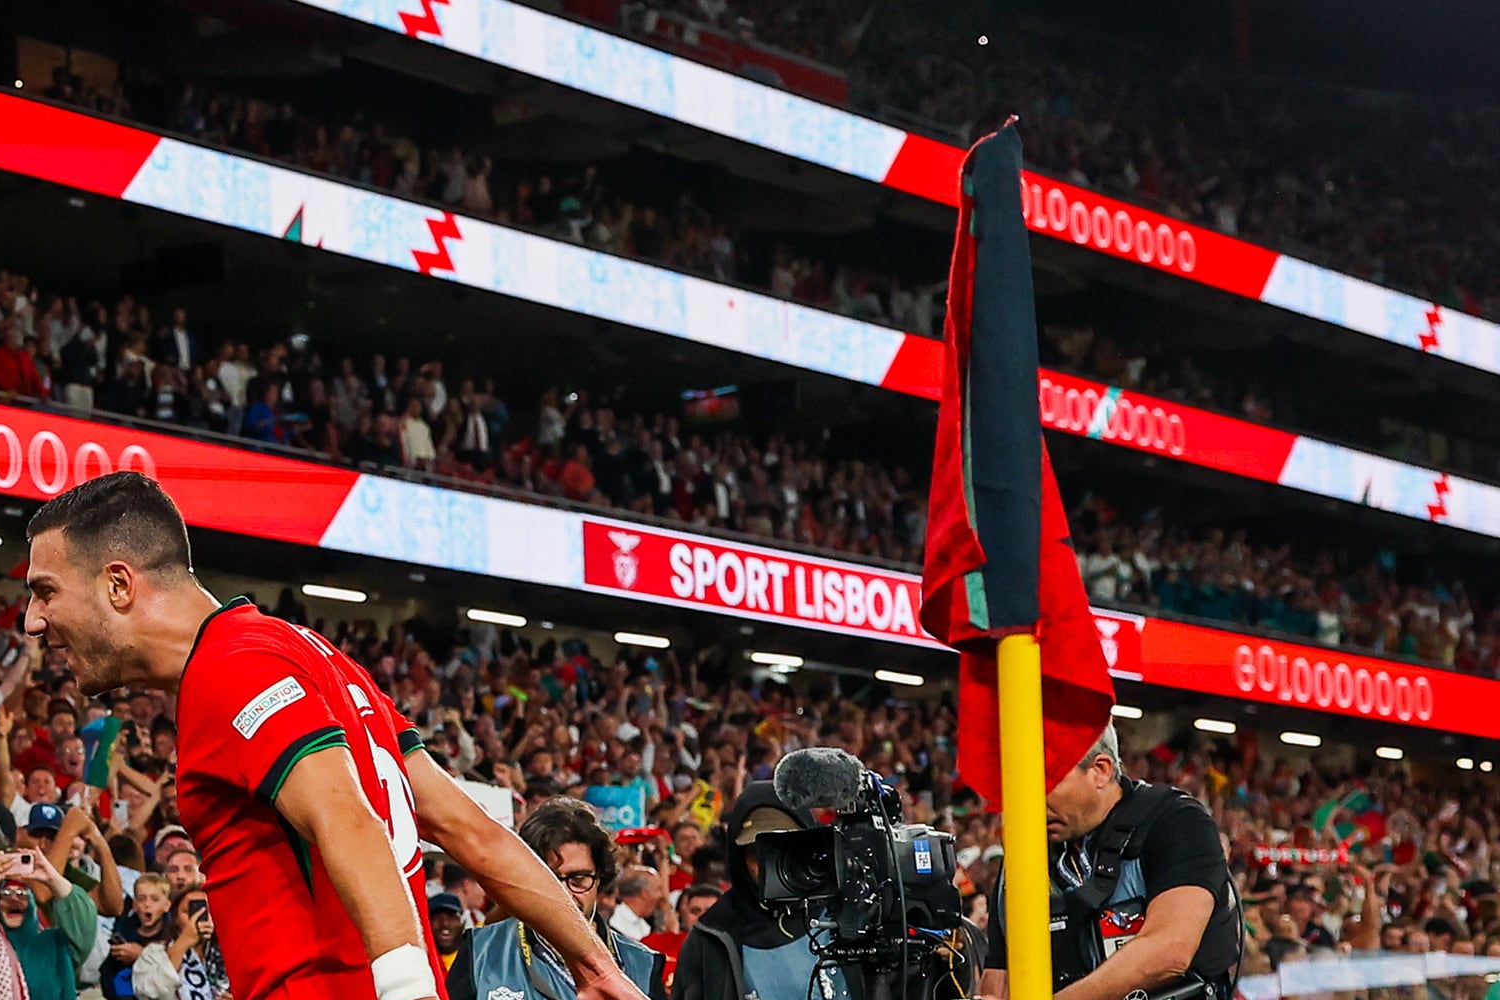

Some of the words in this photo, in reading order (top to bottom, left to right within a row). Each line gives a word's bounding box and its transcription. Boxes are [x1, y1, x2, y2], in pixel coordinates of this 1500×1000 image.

[669, 542, 789, 614] SPORT
[794, 565, 918, 635] LISBOA
[238, 682, 299, 734] FOUNDATION
